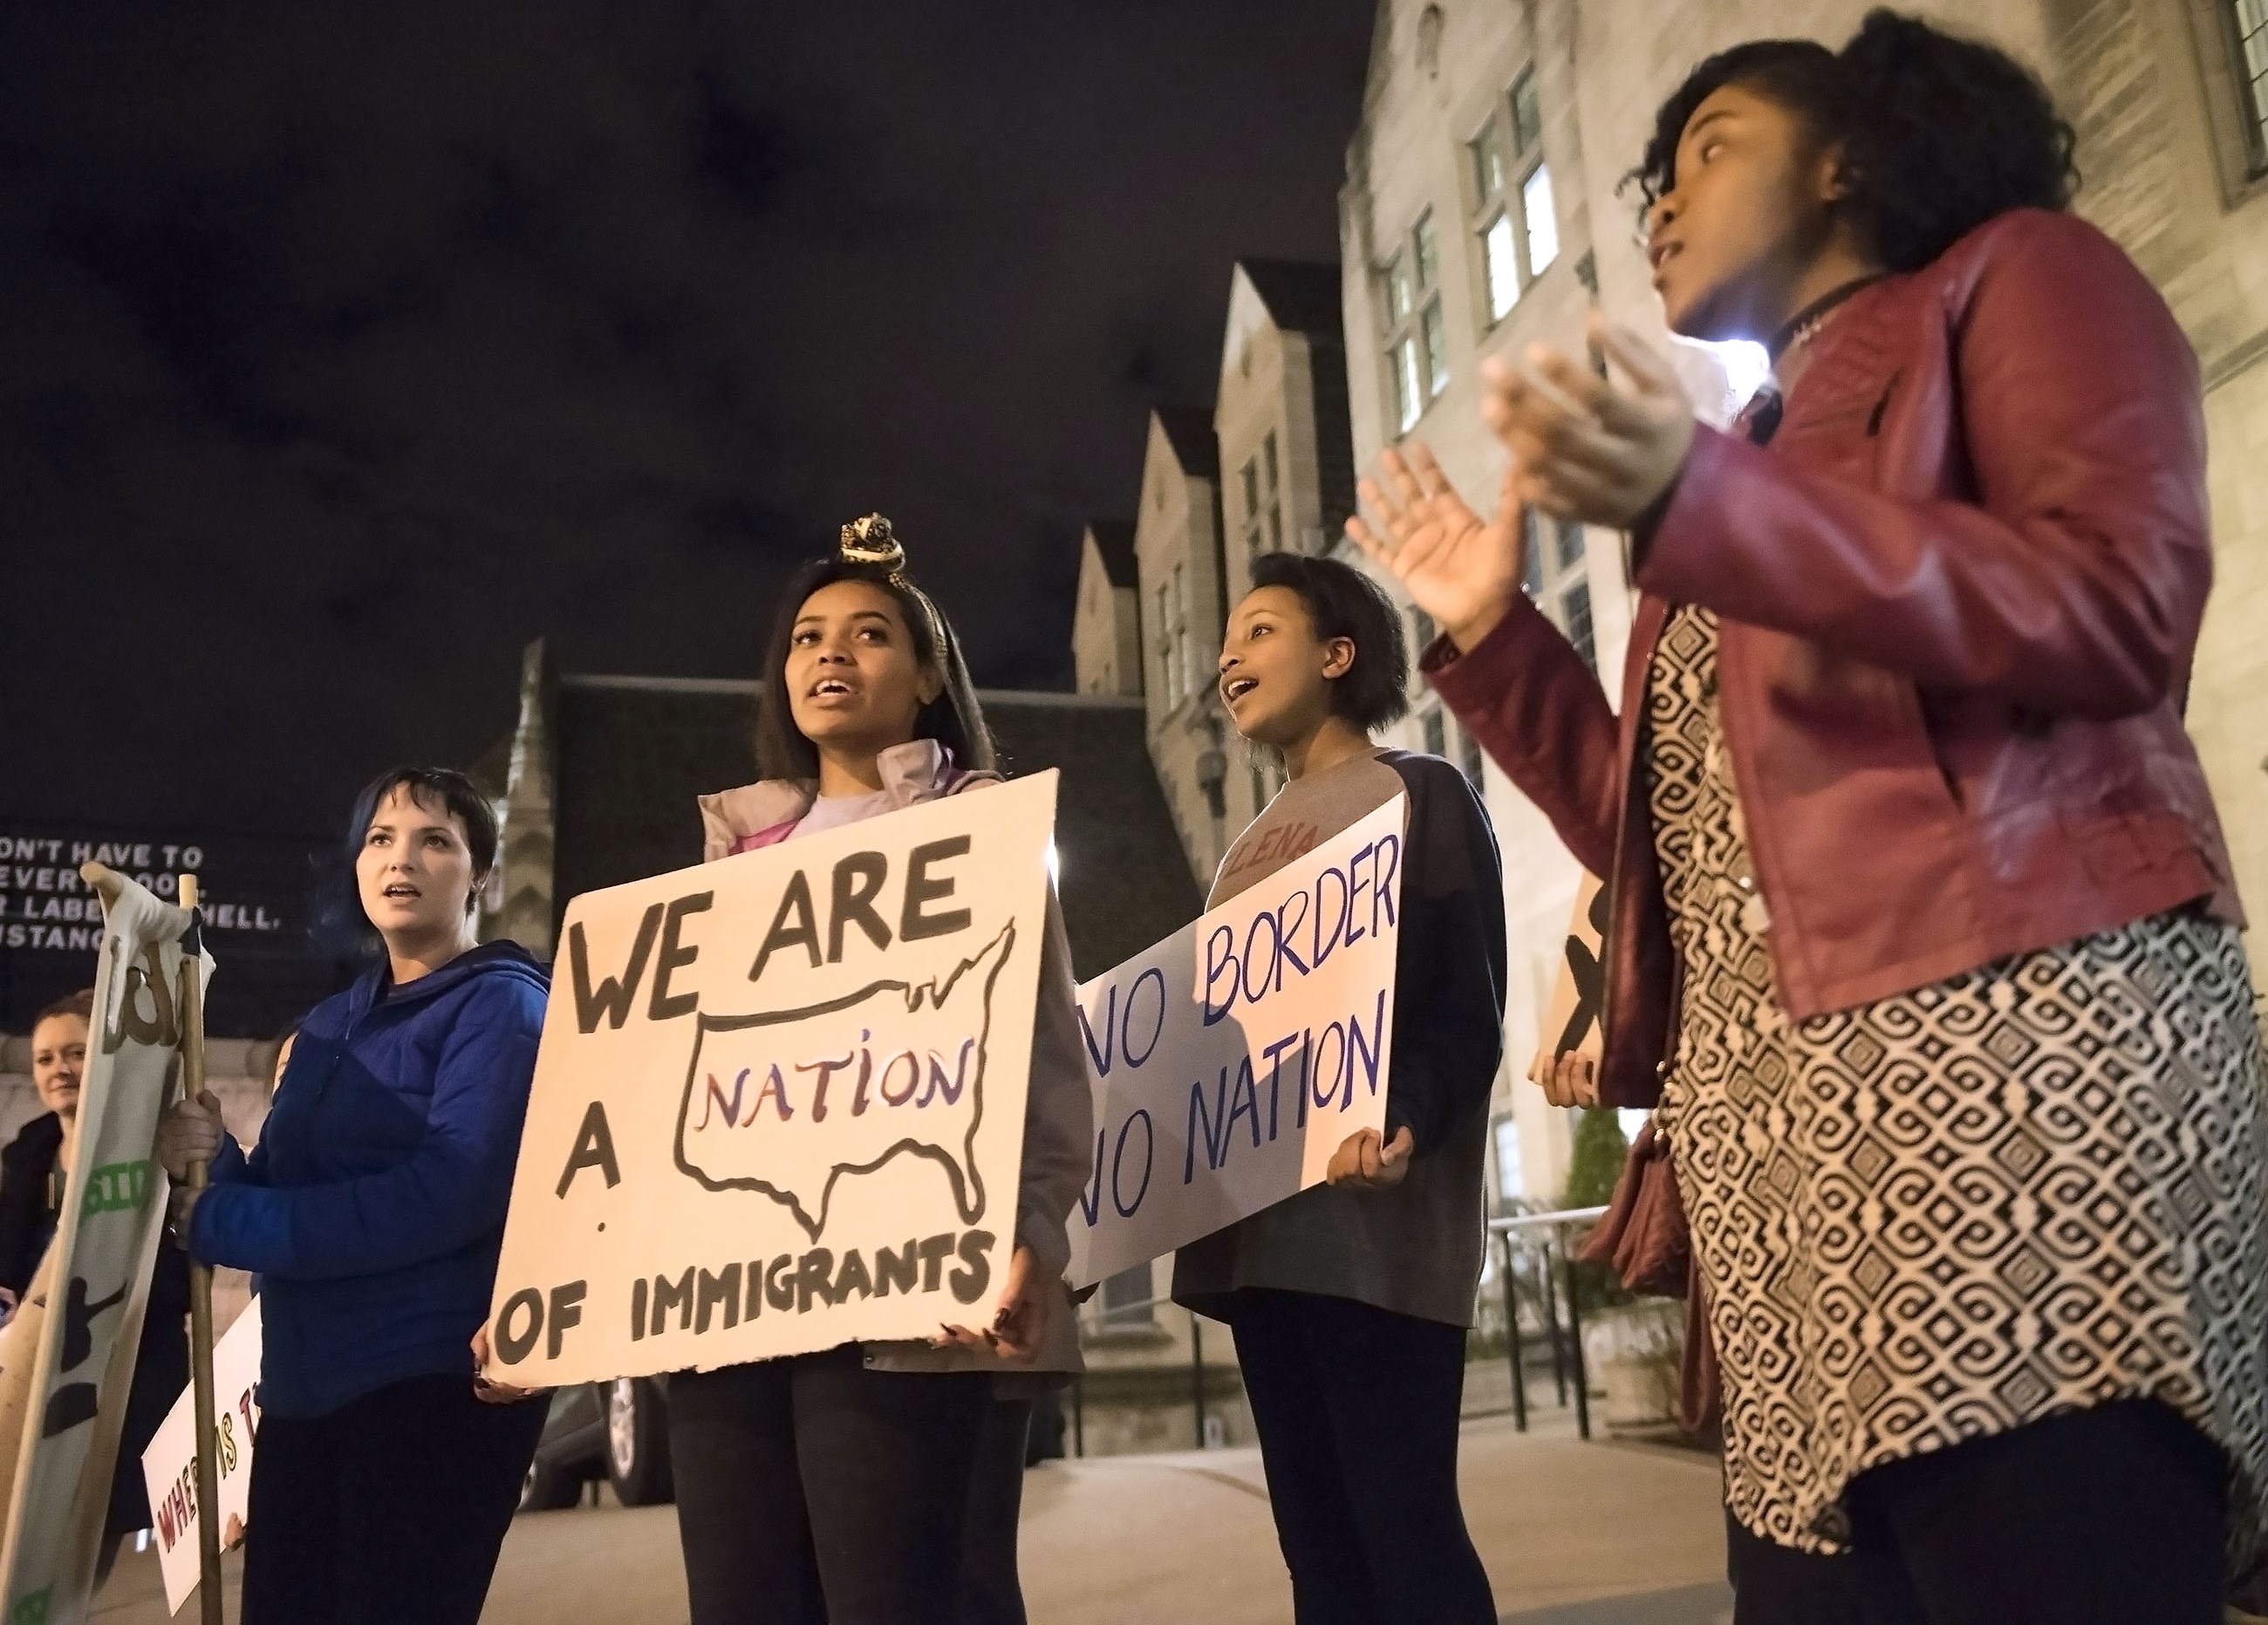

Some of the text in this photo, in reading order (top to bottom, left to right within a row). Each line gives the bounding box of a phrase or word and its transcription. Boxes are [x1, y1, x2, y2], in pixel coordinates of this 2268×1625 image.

[0, 864, 92, 893] EVER
[24, 895, 101, 922] LABE
[72, 840, 151, 868] HAVE
[162, 844, 203, 869] TO
[568, 835, 972, 1034] WE ARE
[1203, 834, 1399, 1028] BORDER
[1184, 988, 1386, 1185] NATION
[557, 1101, 621, 1199] A
[495, 1228, 996, 1365] OF IMMIGRANTS
